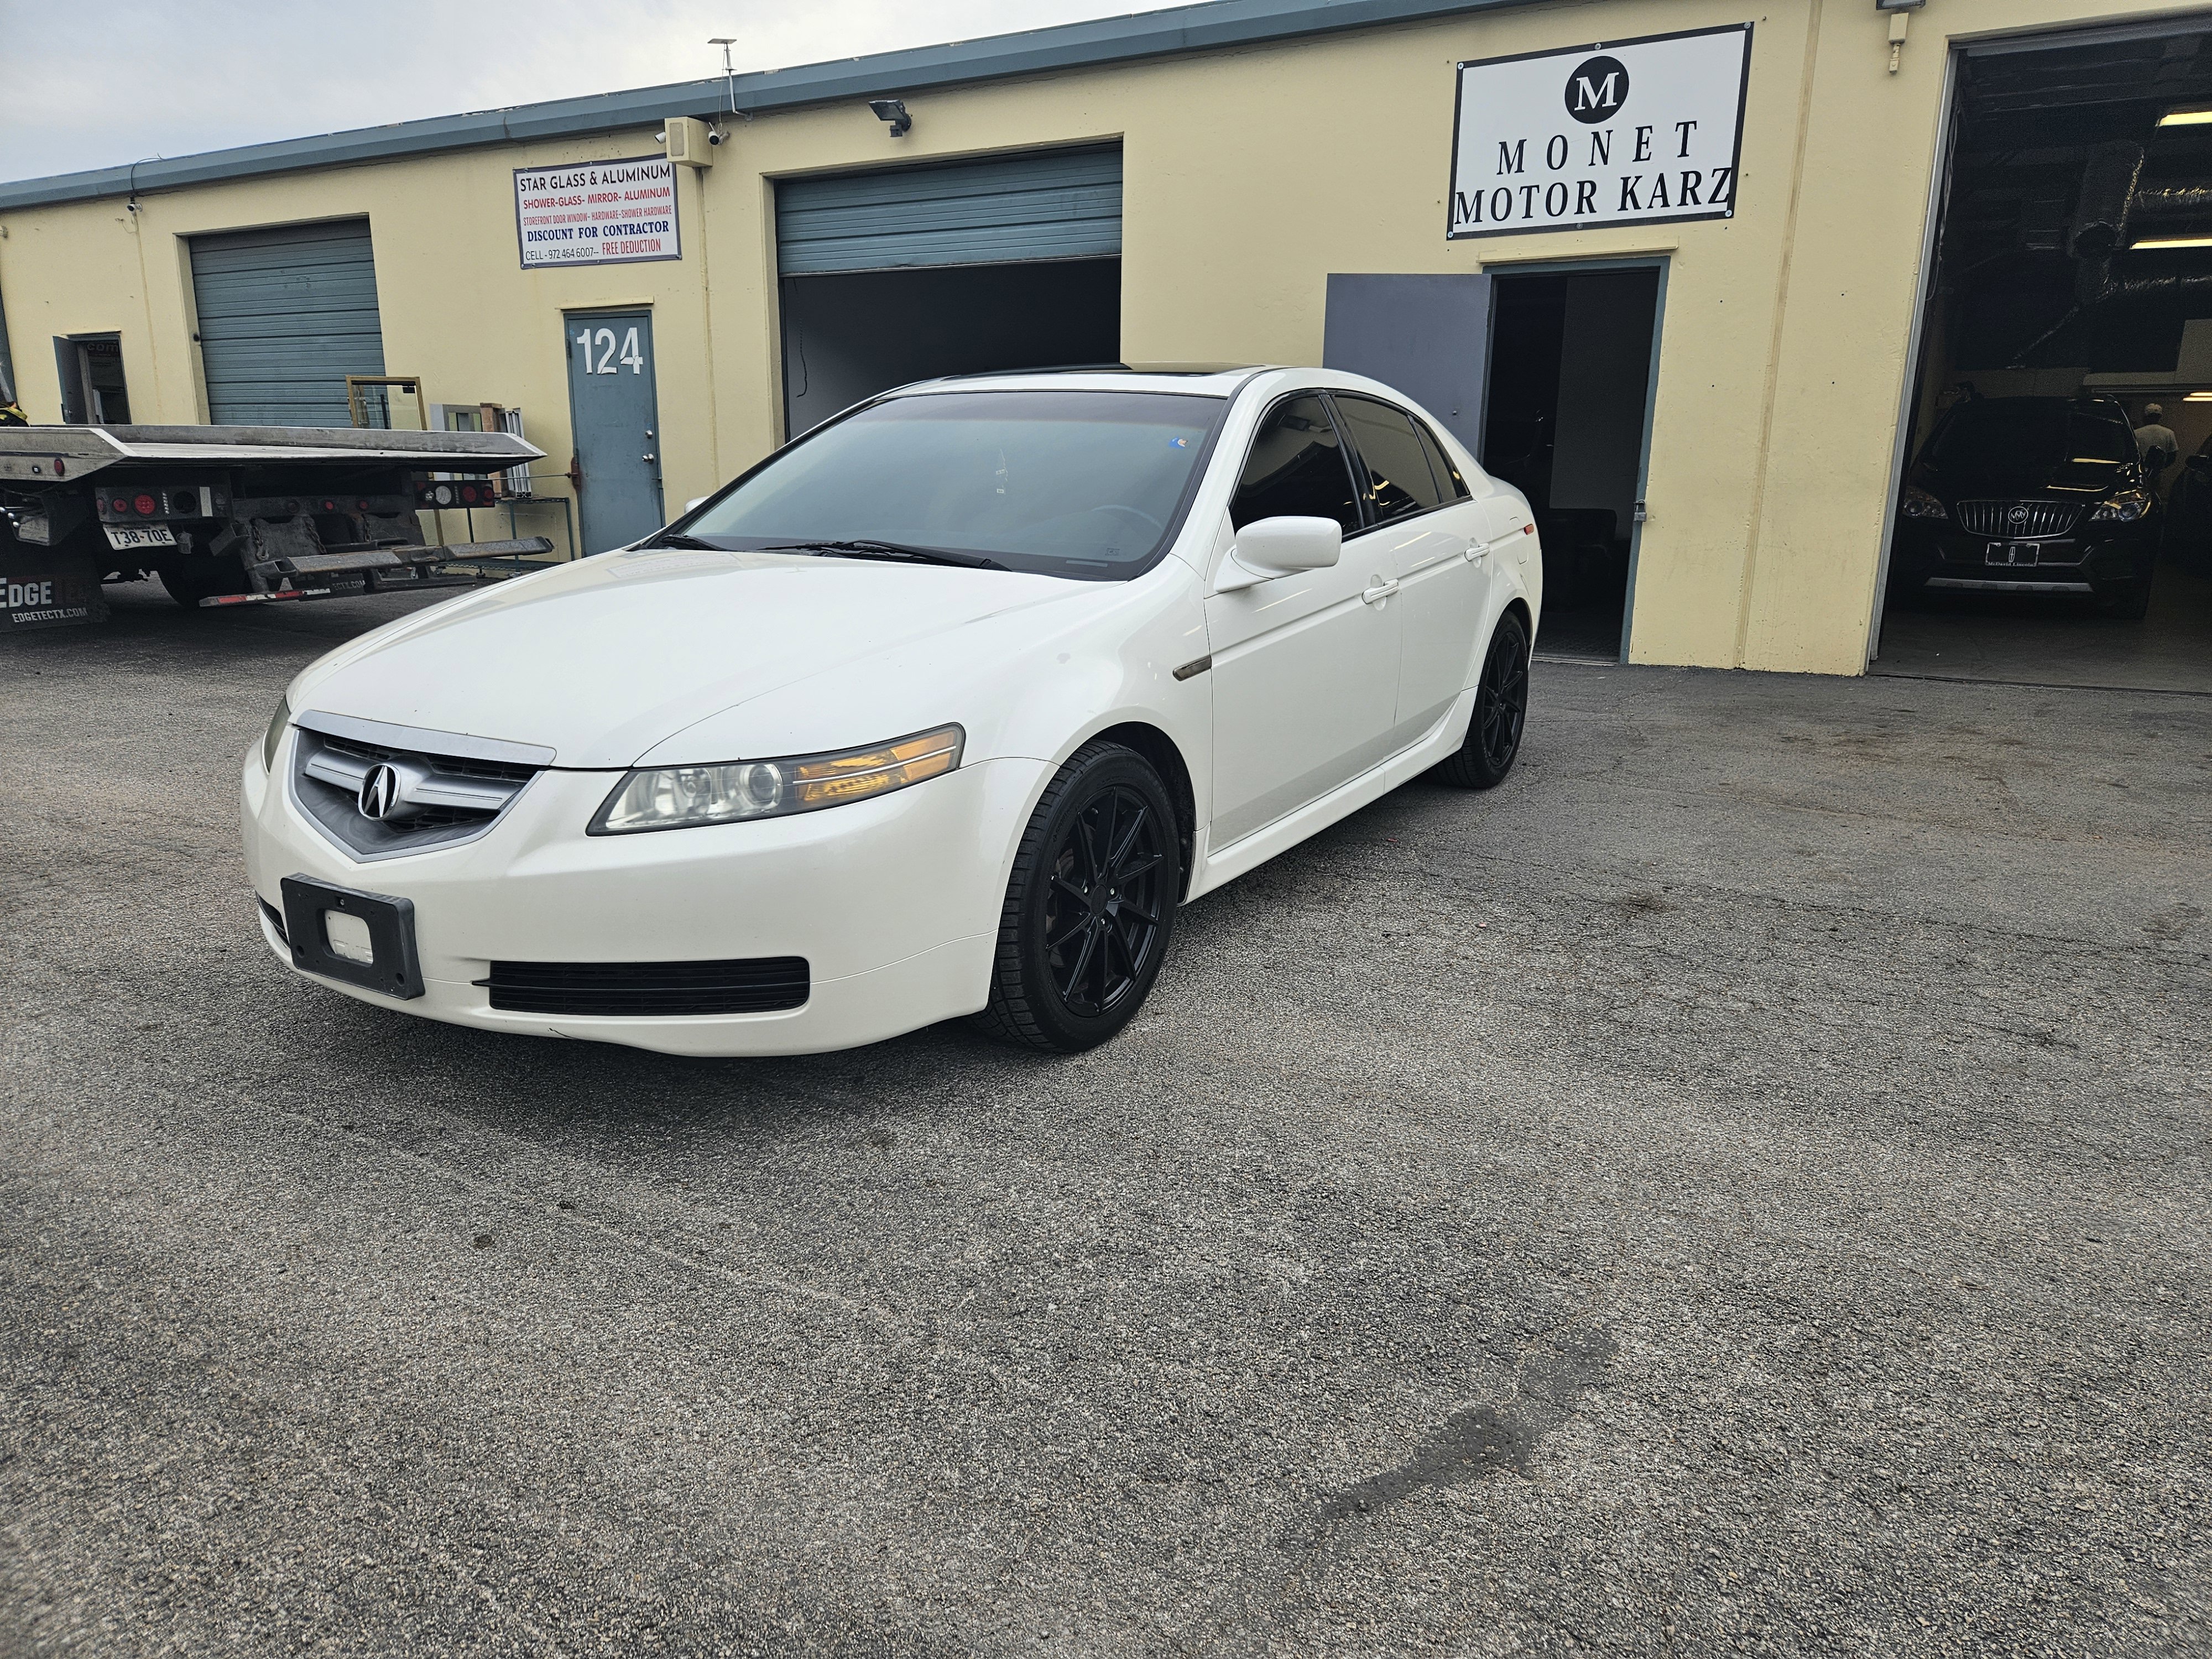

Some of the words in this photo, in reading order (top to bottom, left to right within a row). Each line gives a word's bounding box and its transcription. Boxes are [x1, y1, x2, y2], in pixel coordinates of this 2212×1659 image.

[1574, 72, 1619, 111] M
[1496, 120, 1697, 175] MONET
[520, 177, 546, 191] STAR
[550, 173, 586, 189] GLASS
[589, 171, 598, 185] &
[602, 163, 670, 184] ALUMINUM
[624, 186, 670, 201] ALUMINUM
[1454, 180, 1597, 225] MOTOR
[1617, 167, 1733, 212] KARZ
[523, 215, 552, 226] STOREFRONT
[553, 214, 566, 224] DOOR
[644, 205, 672, 216] HARDWARE
[527, 228, 573, 242] DISCOUNT
[578, 226, 598, 238] FOR
[603, 221, 669, 237] CONTRACTOR
[525, 251, 544, 260] CELL
[549, 249, 561, 259] 972
[562, 248, 575, 258] 464
[602, 242, 619, 255] FREE
[620, 238, 661, 254] DEDUCTION
[576, 327, 644, 374] 124
[11, 607, 88, 623] EDGETECTX.COM
